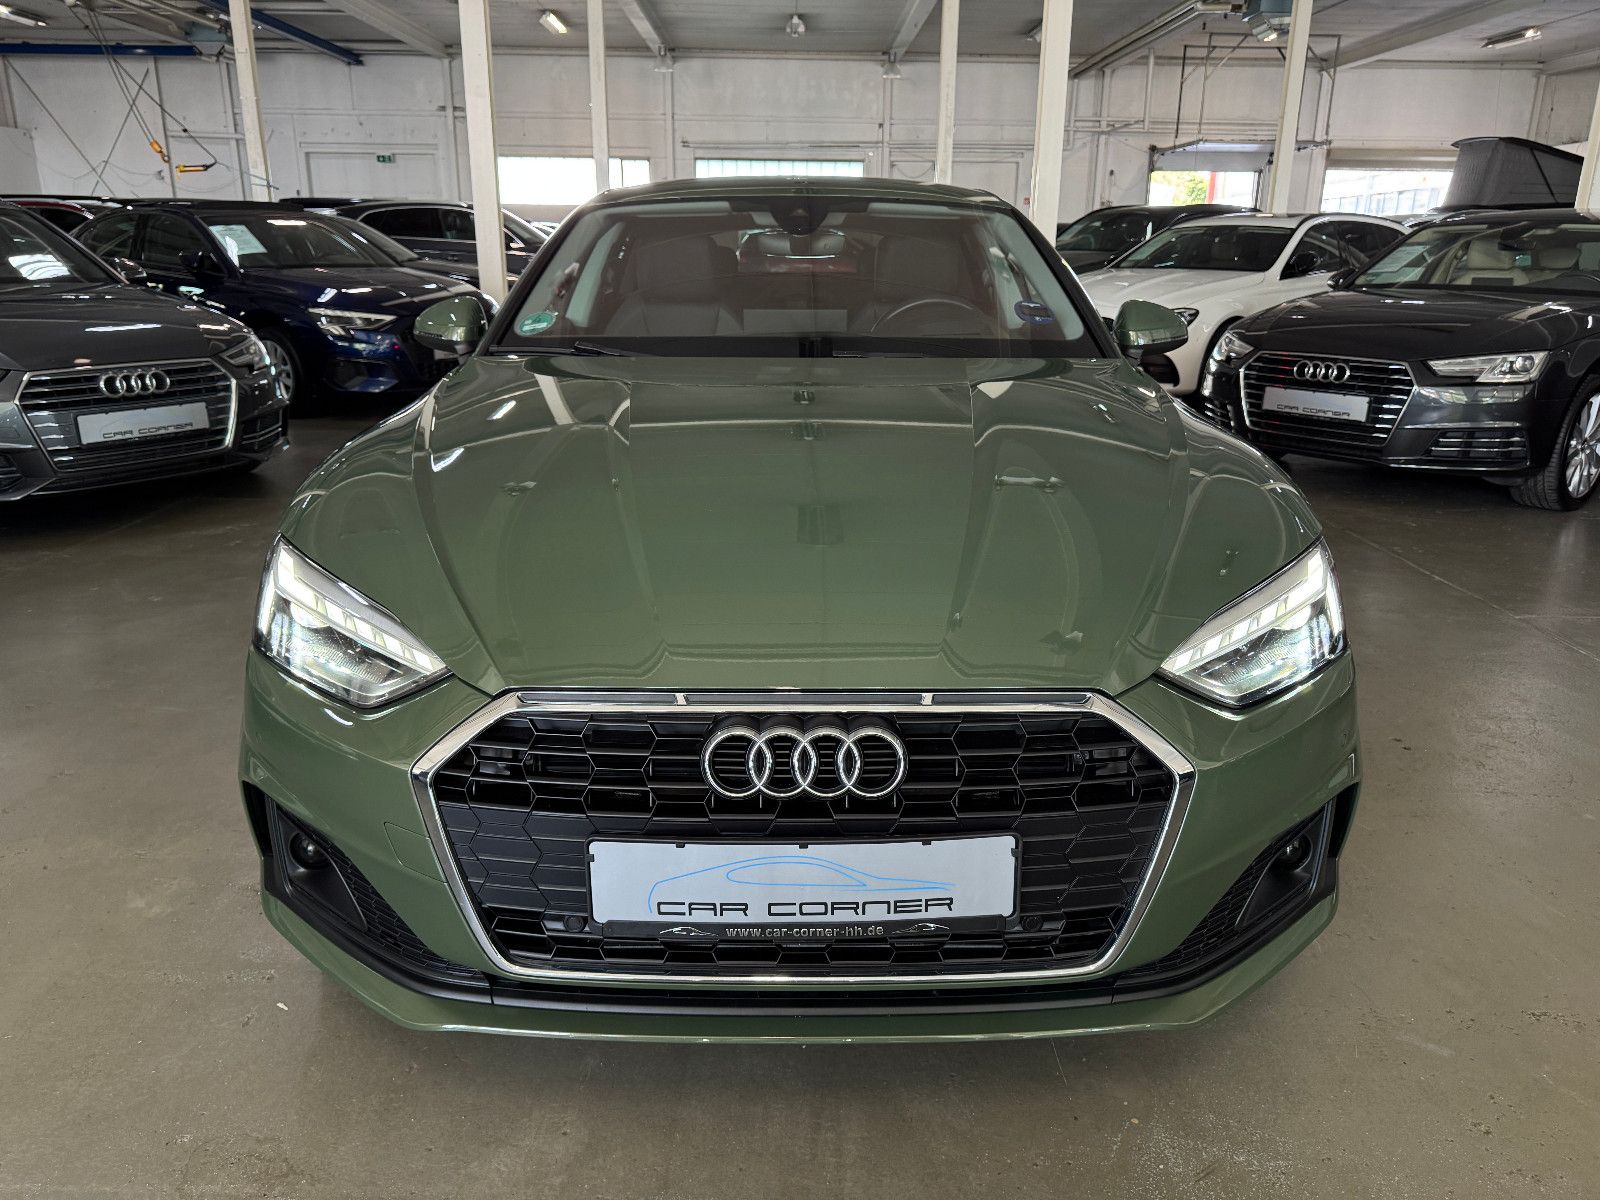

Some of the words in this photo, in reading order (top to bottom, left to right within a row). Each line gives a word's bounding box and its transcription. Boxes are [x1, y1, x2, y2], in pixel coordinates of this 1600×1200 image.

[1302, 407, 1351, 417] CORNER
[102, 429, 134, 439] CAR
[138, 422, 194, 435] CORNER
[656, 901, 749, 917] CAR
[767, 897, 954, 917] CORNER
[725, 925, 884, 938] www.car-corner-hh.de
